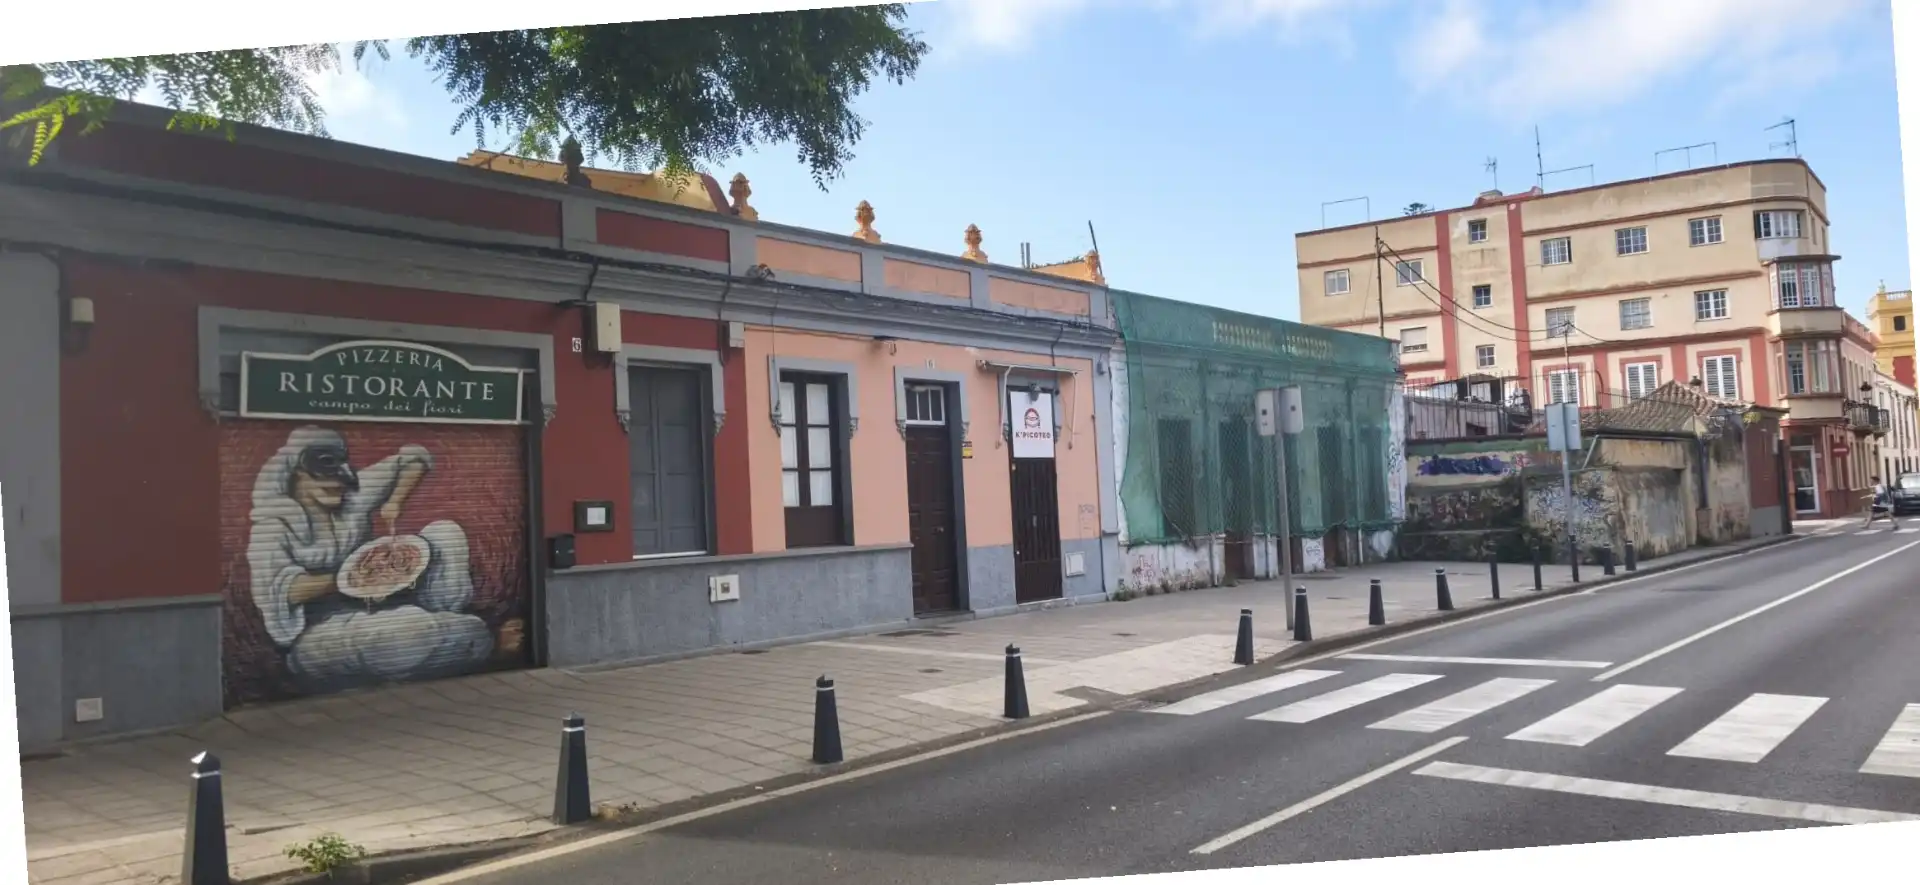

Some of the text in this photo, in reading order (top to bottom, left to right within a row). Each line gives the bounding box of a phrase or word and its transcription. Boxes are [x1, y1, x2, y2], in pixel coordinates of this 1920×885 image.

[573, 339, 581, 351] 6
[336, 349, 443, 372] PIZZERIA
[279, 371, 495, 400] RISTORANTE
[308, 399, 465, 416] campo dei fiori
